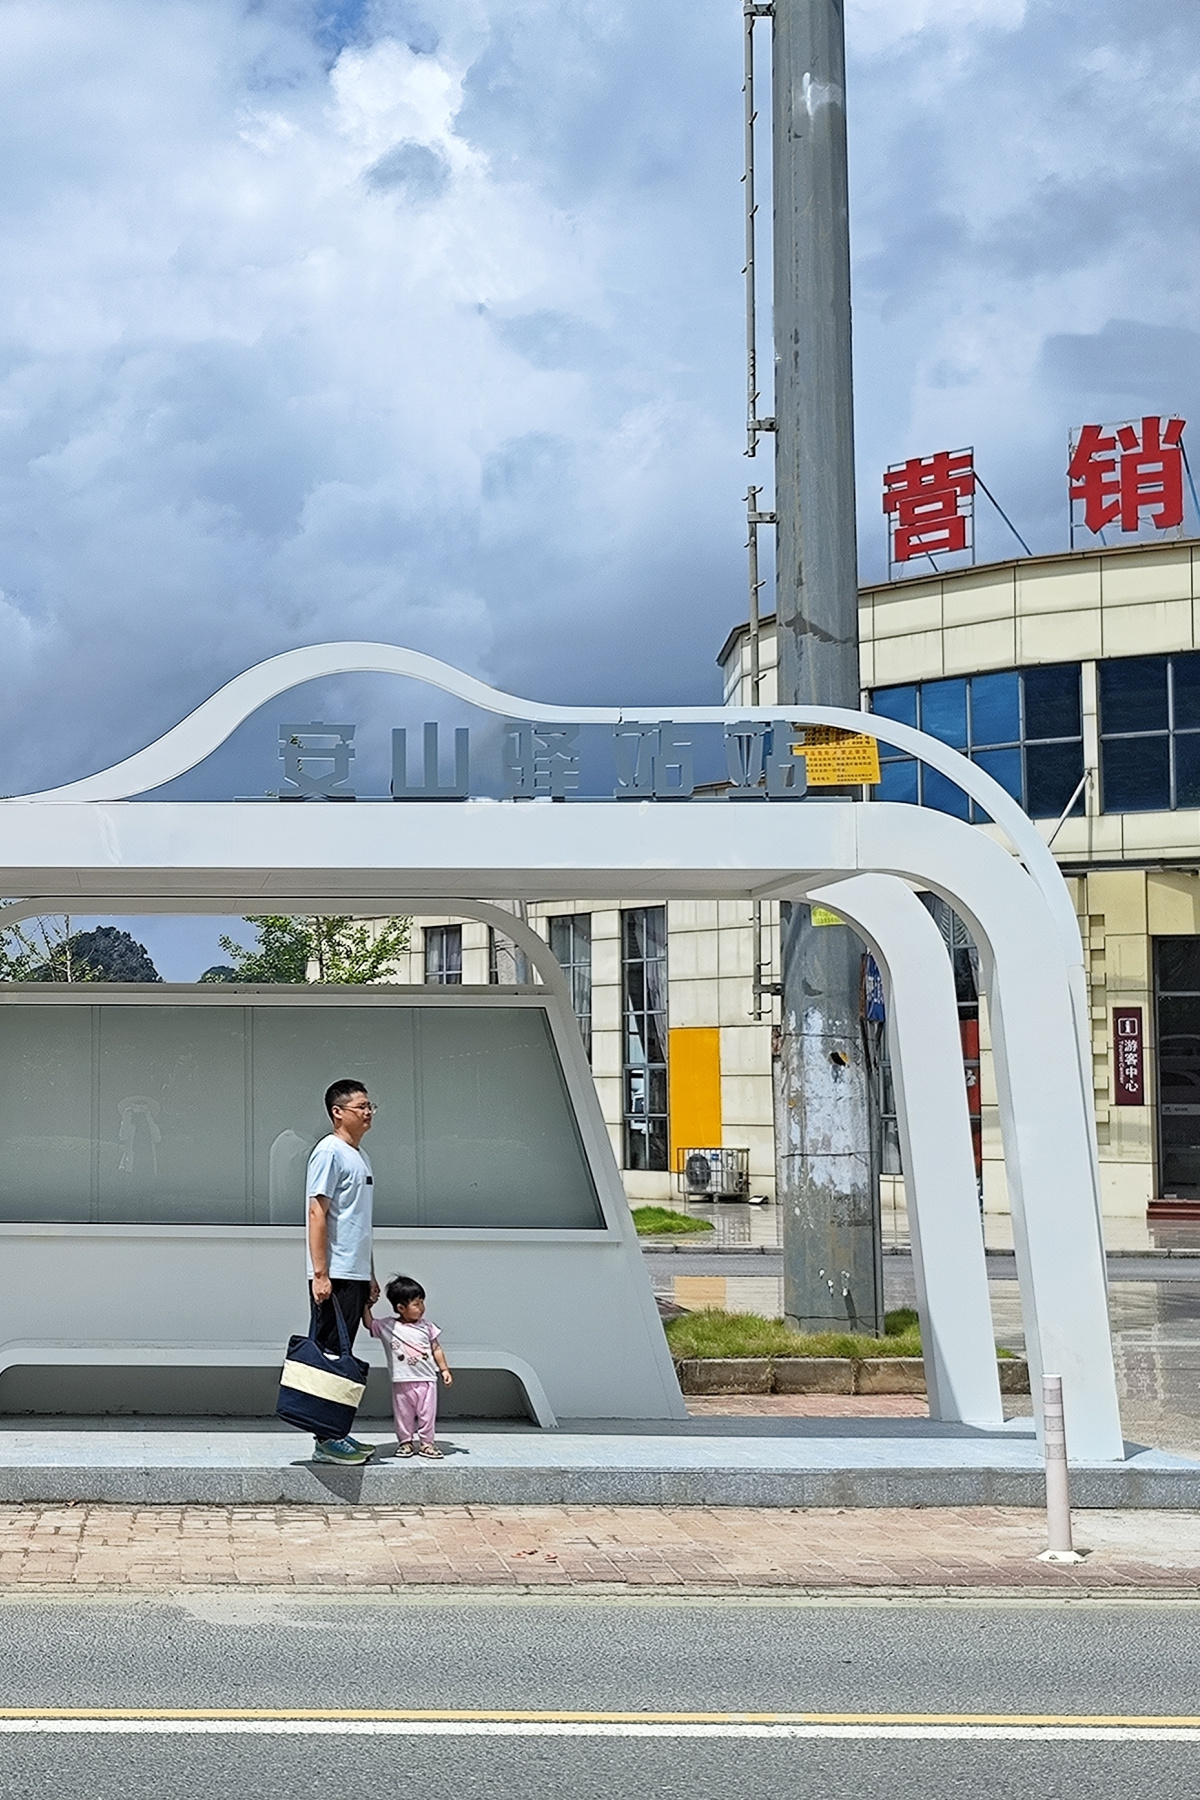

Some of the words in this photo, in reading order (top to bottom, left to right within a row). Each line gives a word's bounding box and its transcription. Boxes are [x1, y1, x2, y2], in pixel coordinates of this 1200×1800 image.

[882, 416, 1186, 562] 营销
[278, 720, 806, 799] 安山驿站站
[1124, 1039, 1139, 1092] 游客中心
